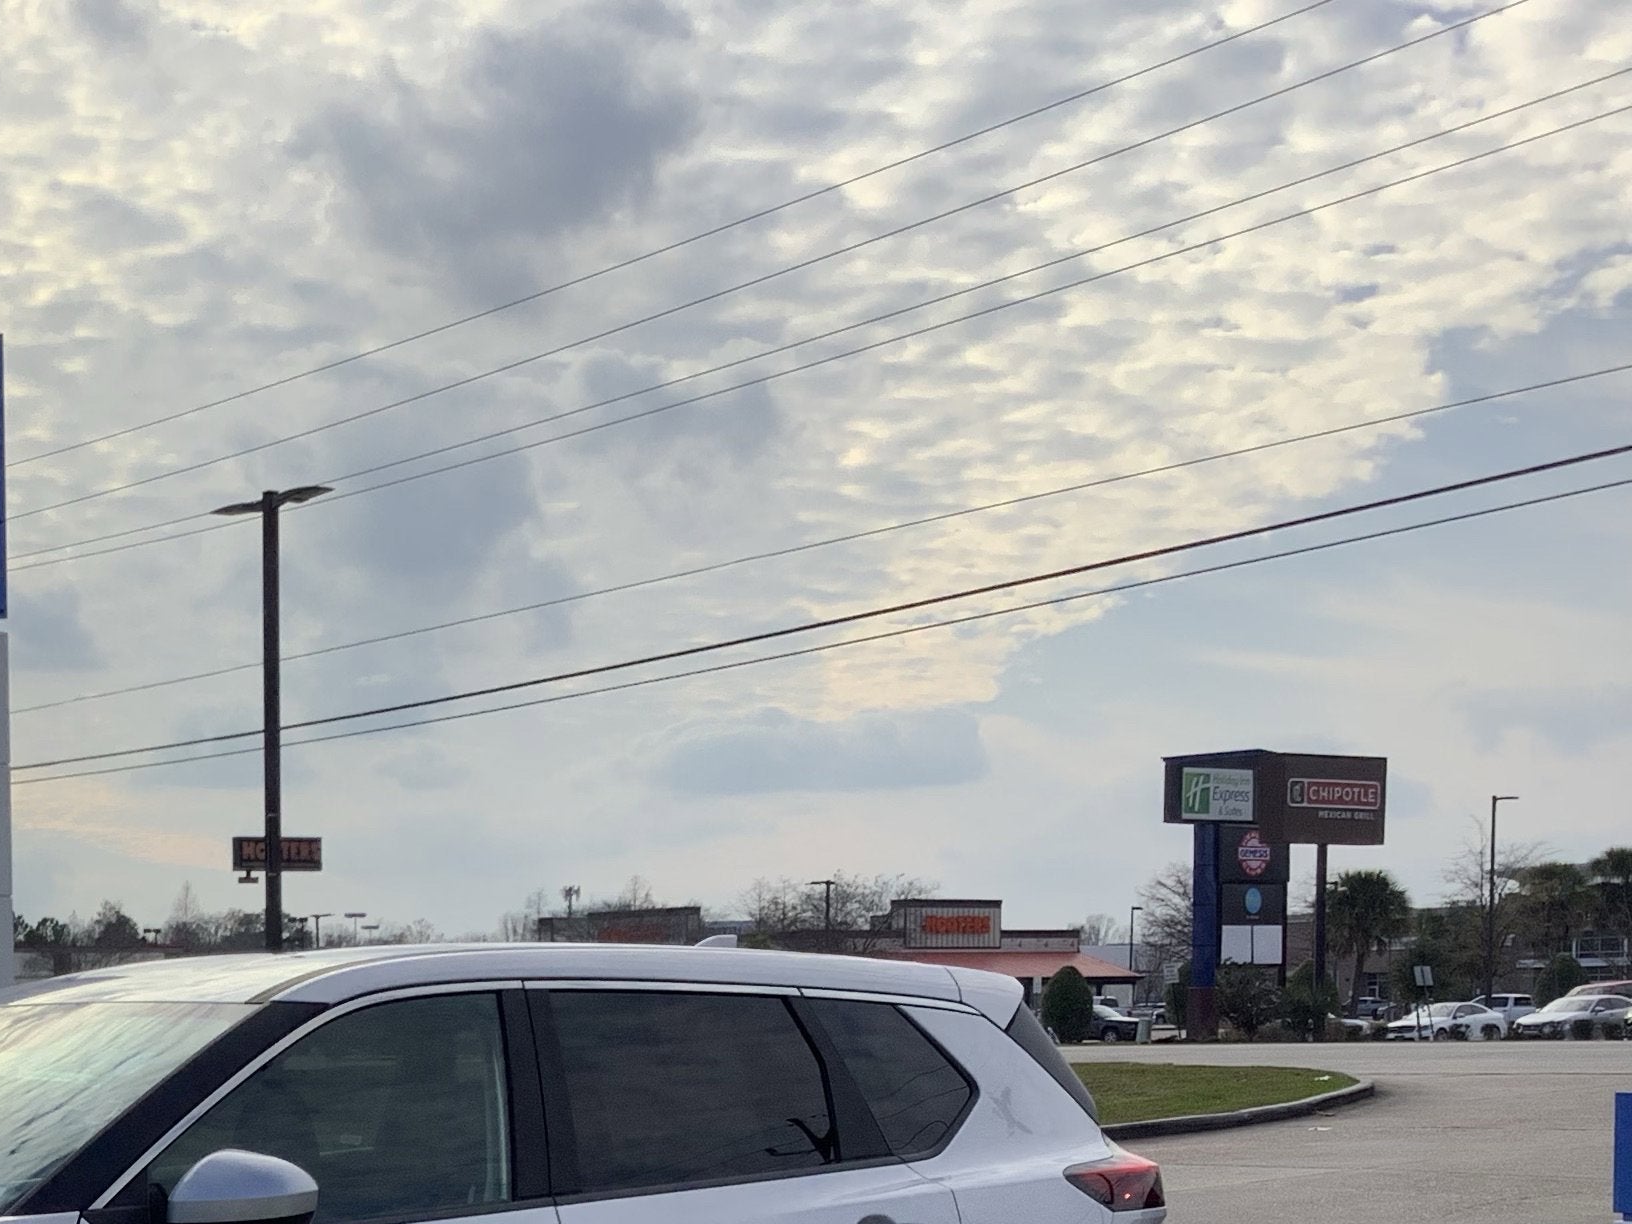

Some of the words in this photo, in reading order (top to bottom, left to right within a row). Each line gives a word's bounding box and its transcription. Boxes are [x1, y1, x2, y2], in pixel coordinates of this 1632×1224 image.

[1212, 785, 1251, 804] Express
[1309, 786, 1376, 802] CHIPOTLE
[1318, 810, 1351, 819] MEXICAN
[1353, 811, 1374, 820] GRILL
[241, 841, 321, 860] HOTERS
